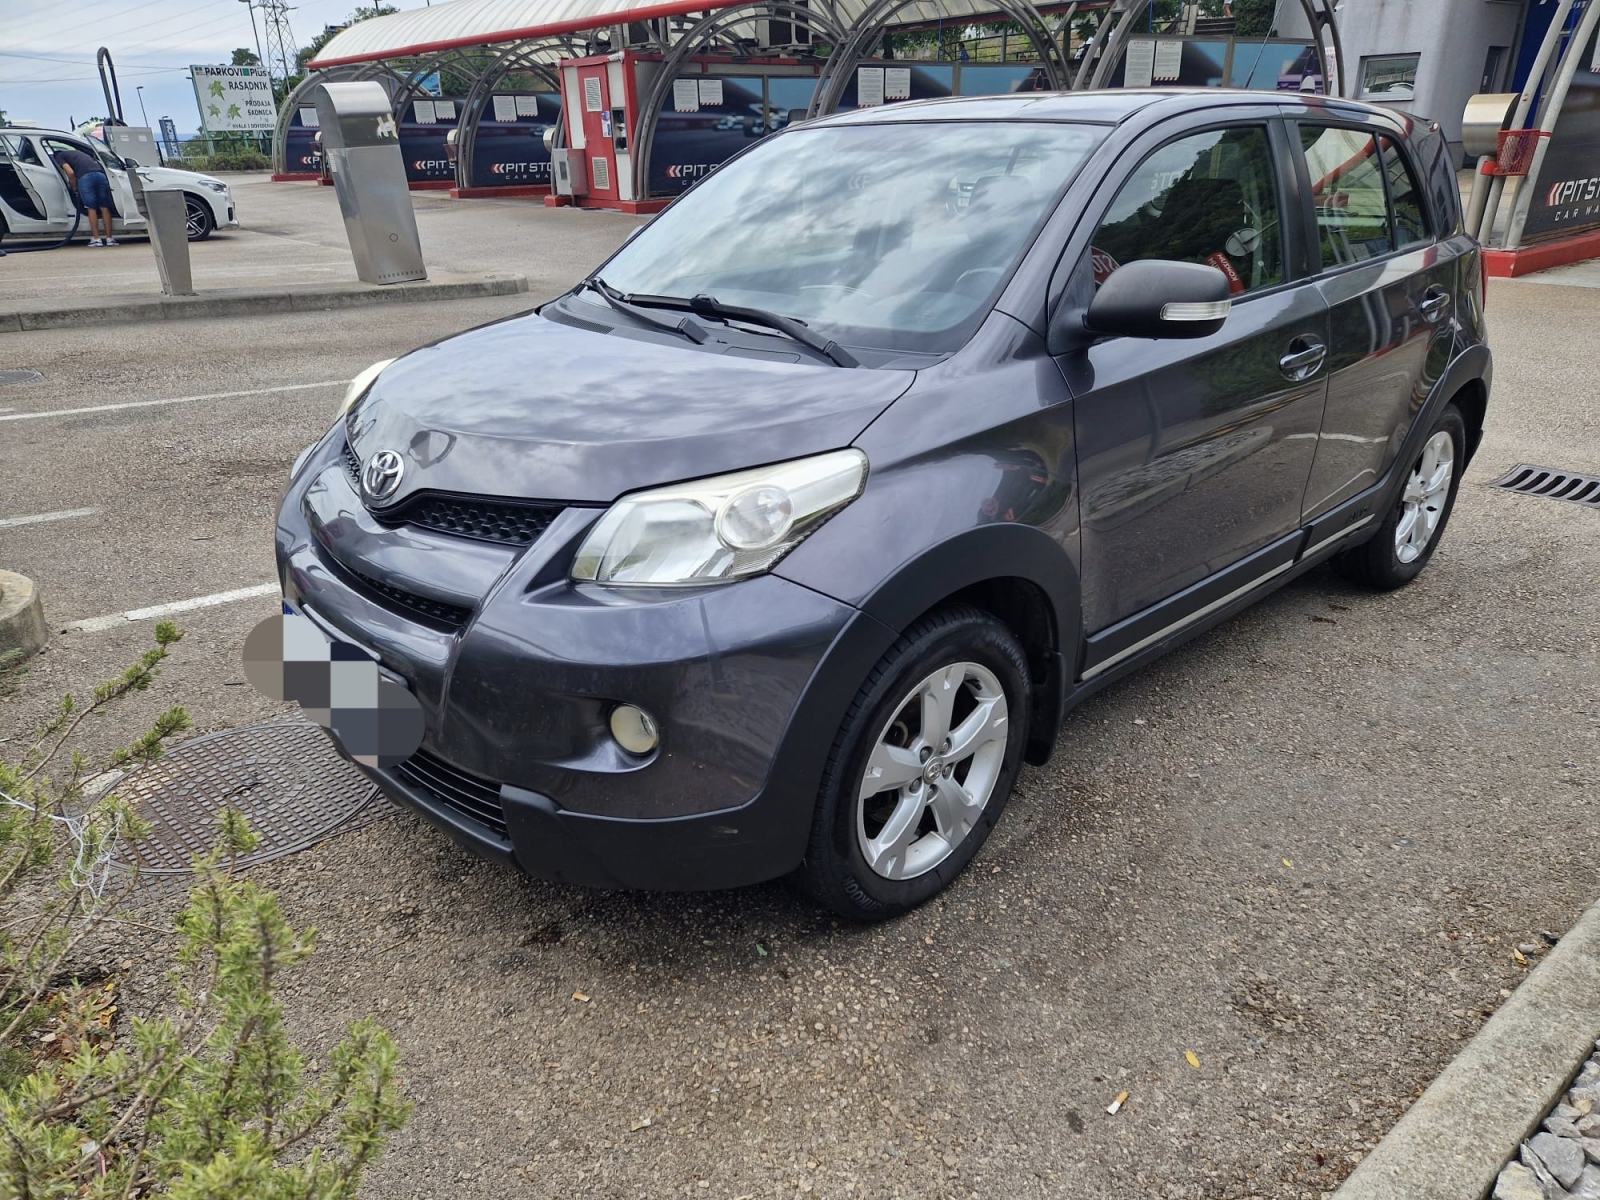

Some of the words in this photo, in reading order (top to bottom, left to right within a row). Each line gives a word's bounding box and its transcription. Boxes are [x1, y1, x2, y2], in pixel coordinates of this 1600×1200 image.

[205, 67, 242, 77] PARKOVI
[249, 68, 268, 77] Plus
[228, 81, 268, 91] RASADNIK
[427, 160, 447, 169] PIT
[505, 163, 527, 173] PIT
[682, 164, 707, 177] PIT
[1560, 179, 1588, 204] PIT
[1554, 208, 1579, 222] CAR
